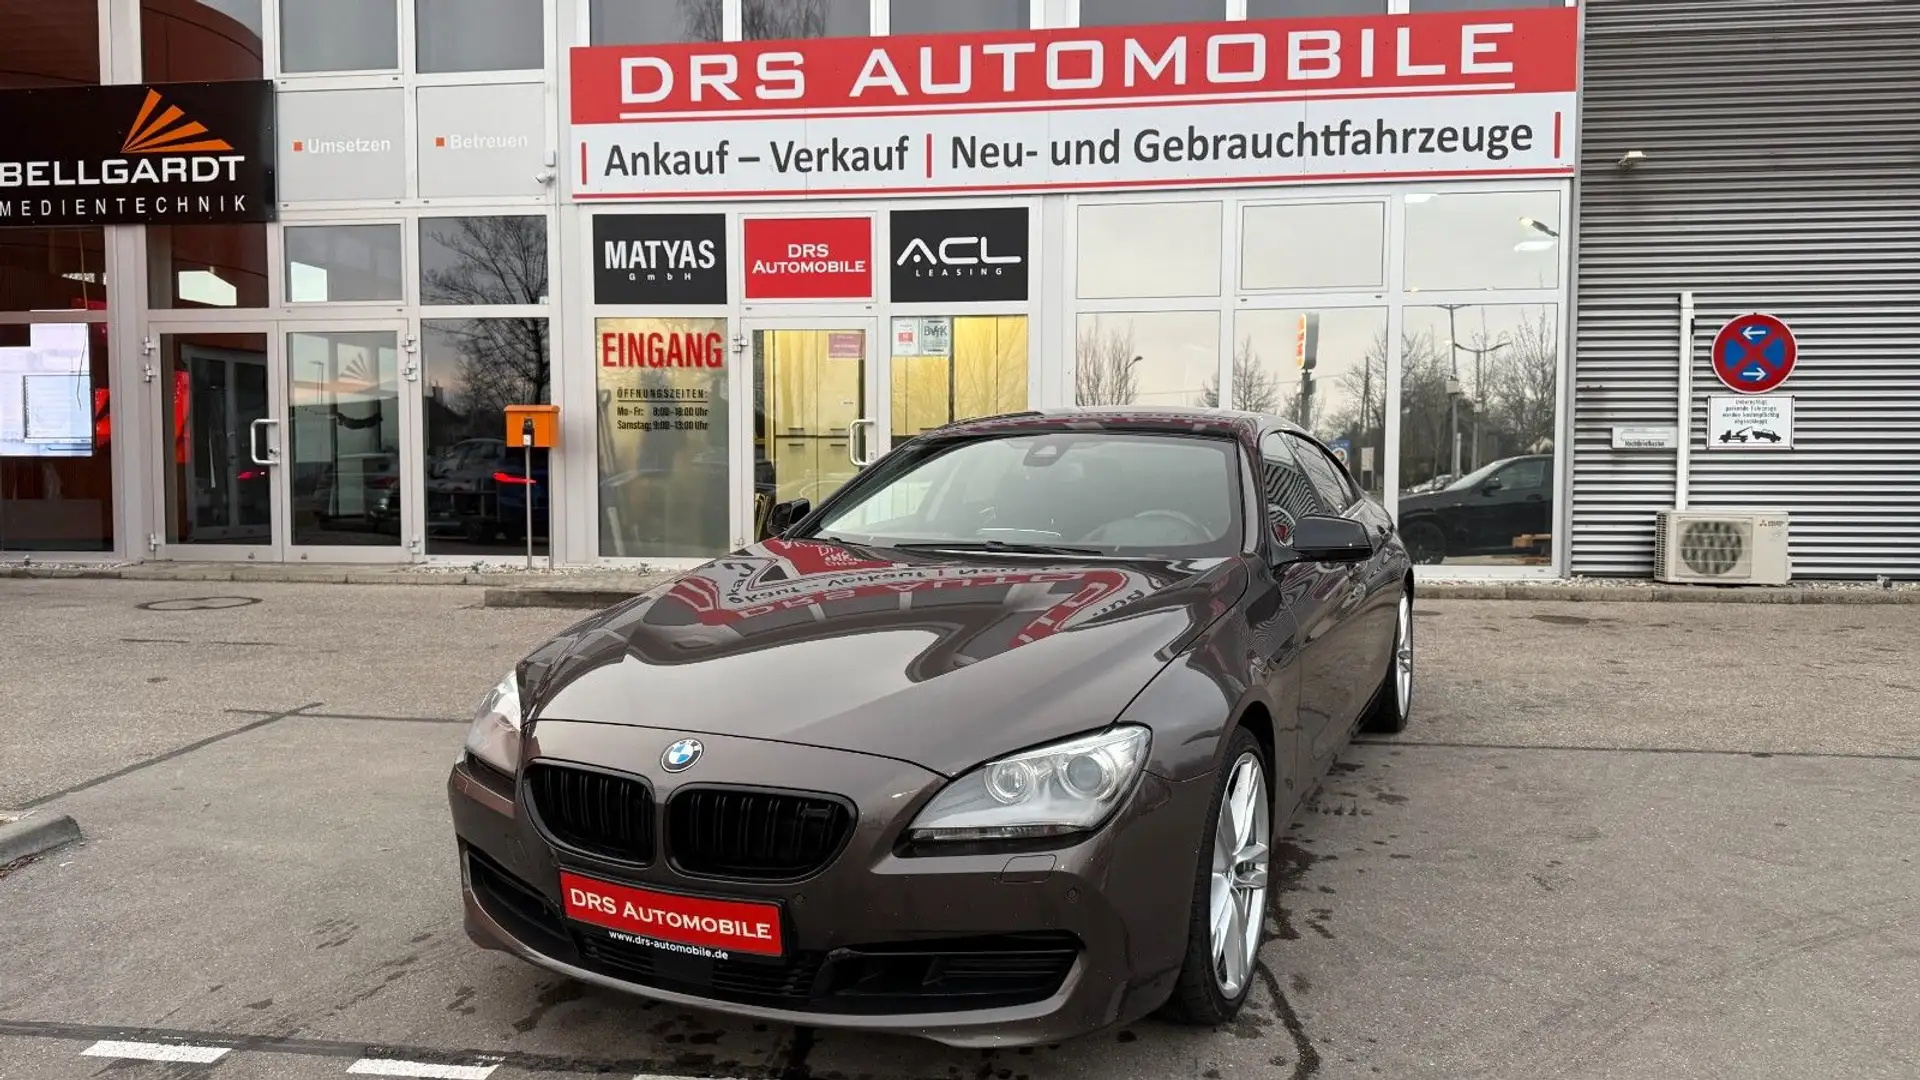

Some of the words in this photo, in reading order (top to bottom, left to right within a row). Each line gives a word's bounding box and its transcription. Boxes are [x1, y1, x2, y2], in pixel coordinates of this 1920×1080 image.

[620, 51, 805, 104] DRS
[849, 23, 1513, 97] AUTOMOBILE
[308, 138, 390, 153] Umsetzen
[450, 134, 527, 149] Betreuen
[604, 140, 729, 177] Ankauf
[770, 135, 909, 173] Verkauf
[952, 136, 1038, 169] Neu-
[1051, 128, 1120, 166] und
[1134, 118, 1533, 163] Gebrauchtfahrzeuge
[0, 156, 245, 187] BELLGARDT
[0, 194, 246, 217] MEDIENTECHNIK
[604, 240, 716, 269] MATYAS
[788, 244, 829, 258] DRS
[897, 236, 1022, 265] ACL
[752, 260, 866, 274] AUTOMOBILE
[915, 267, 1002, 277] LEASING
[602, 332, 723, 368] EINGANG
[617, 387, 708, 399] ÖFFNUNGSZEITEN:
[695, 407, 709, 417] Uhr
[695, 420, 709, 430] Uhr
[570, 888, 617, 914] DRS
[623, 901, 772, 939] AUTOMOBILE
[608, 930, 729, 960] www.drs-automobile.de
